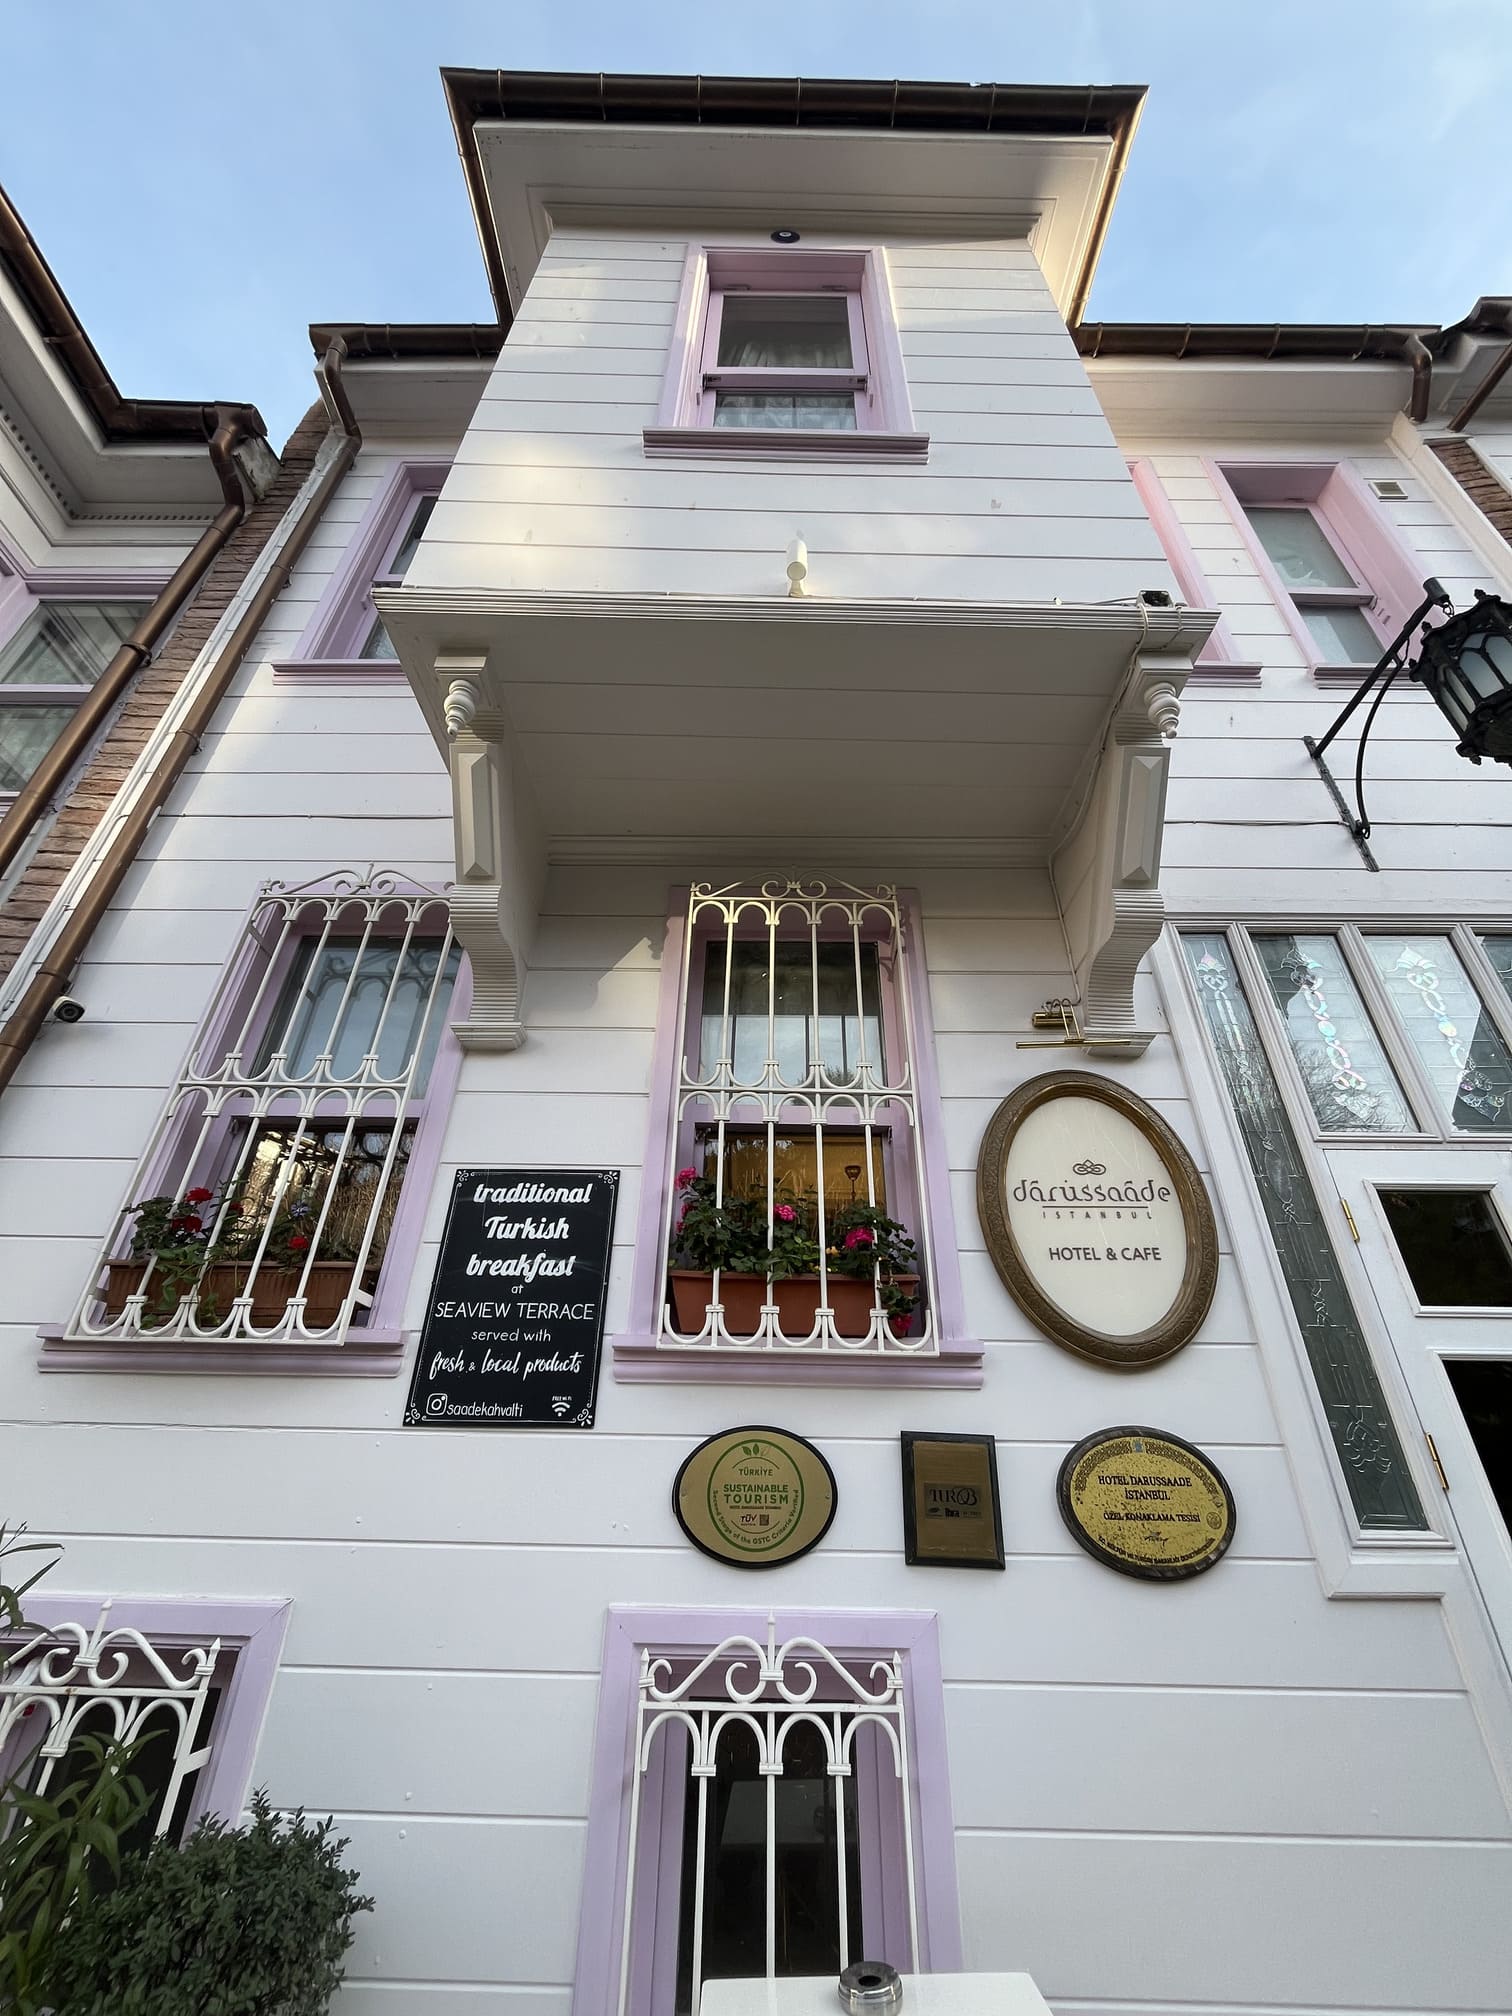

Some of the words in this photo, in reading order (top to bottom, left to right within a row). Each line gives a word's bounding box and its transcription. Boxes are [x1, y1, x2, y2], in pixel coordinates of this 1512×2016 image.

[473, 1182, 593, 1203] traditional
[484, 1215, 570, 1239] Turkish
[1048, 1247, 1101, 1261] HOTEL
[1106, 1247, 1118, 1261] &
[1121, 1247, 1162, 1261] CAFE
[466, 1252, 577, 1283] breakfast
[511, 1284, 524, 1295] at
[434, 1302, 511, 1319] SEAVIEW
[517, 1303, 595, 1320] TERRACE
[471, 1328, 519, 1342] served
[523, 1329, 552, 1342] with
[429, 1349, 465, 1381] fresh
[468, 1361, 476, 1371] &
[481, 1348, 519, 1374] local
[523, 1351, 585, 1381] products
[446, 1401, 523, 1417] saadekahvalti
[738, 1466, 774, 1477] TÜRKİYE
[723, 1483, 789, 1493] SUSTAINABLE
[1098, 1475, 1129, 1486] HOTEL
[1130, 1475, 1193, 1487] DARUSSAADE
[723, 1493, 789, 1504] TOURISM
[1124, 1512, 1176, 1522] KONAKLAMA
